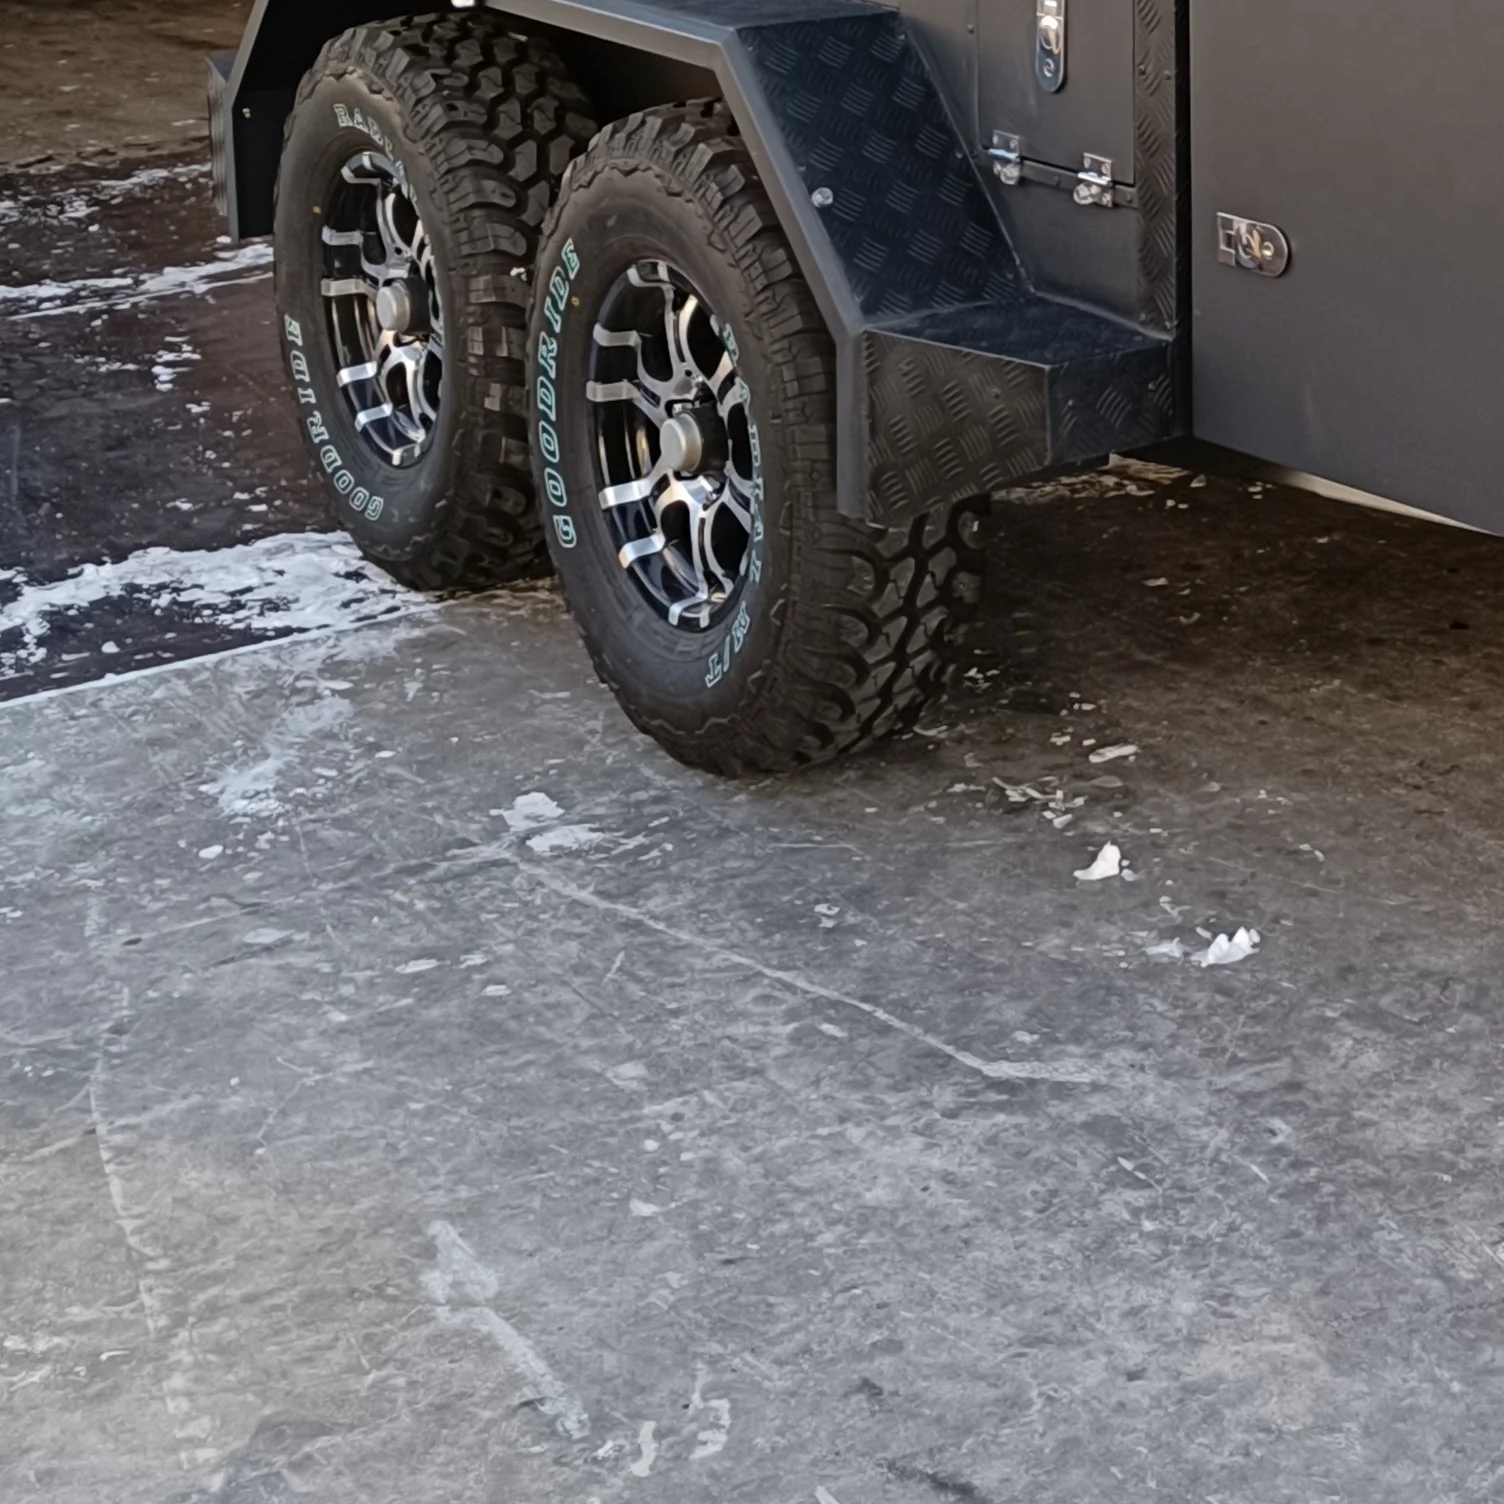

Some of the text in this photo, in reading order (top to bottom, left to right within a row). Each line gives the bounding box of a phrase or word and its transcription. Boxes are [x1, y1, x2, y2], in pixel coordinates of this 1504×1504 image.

[284, 314, 384, 522] GOODRIDE
[536, 237, 582, 549] GOODRIDE
[705, 600, 751, 689] M/T
